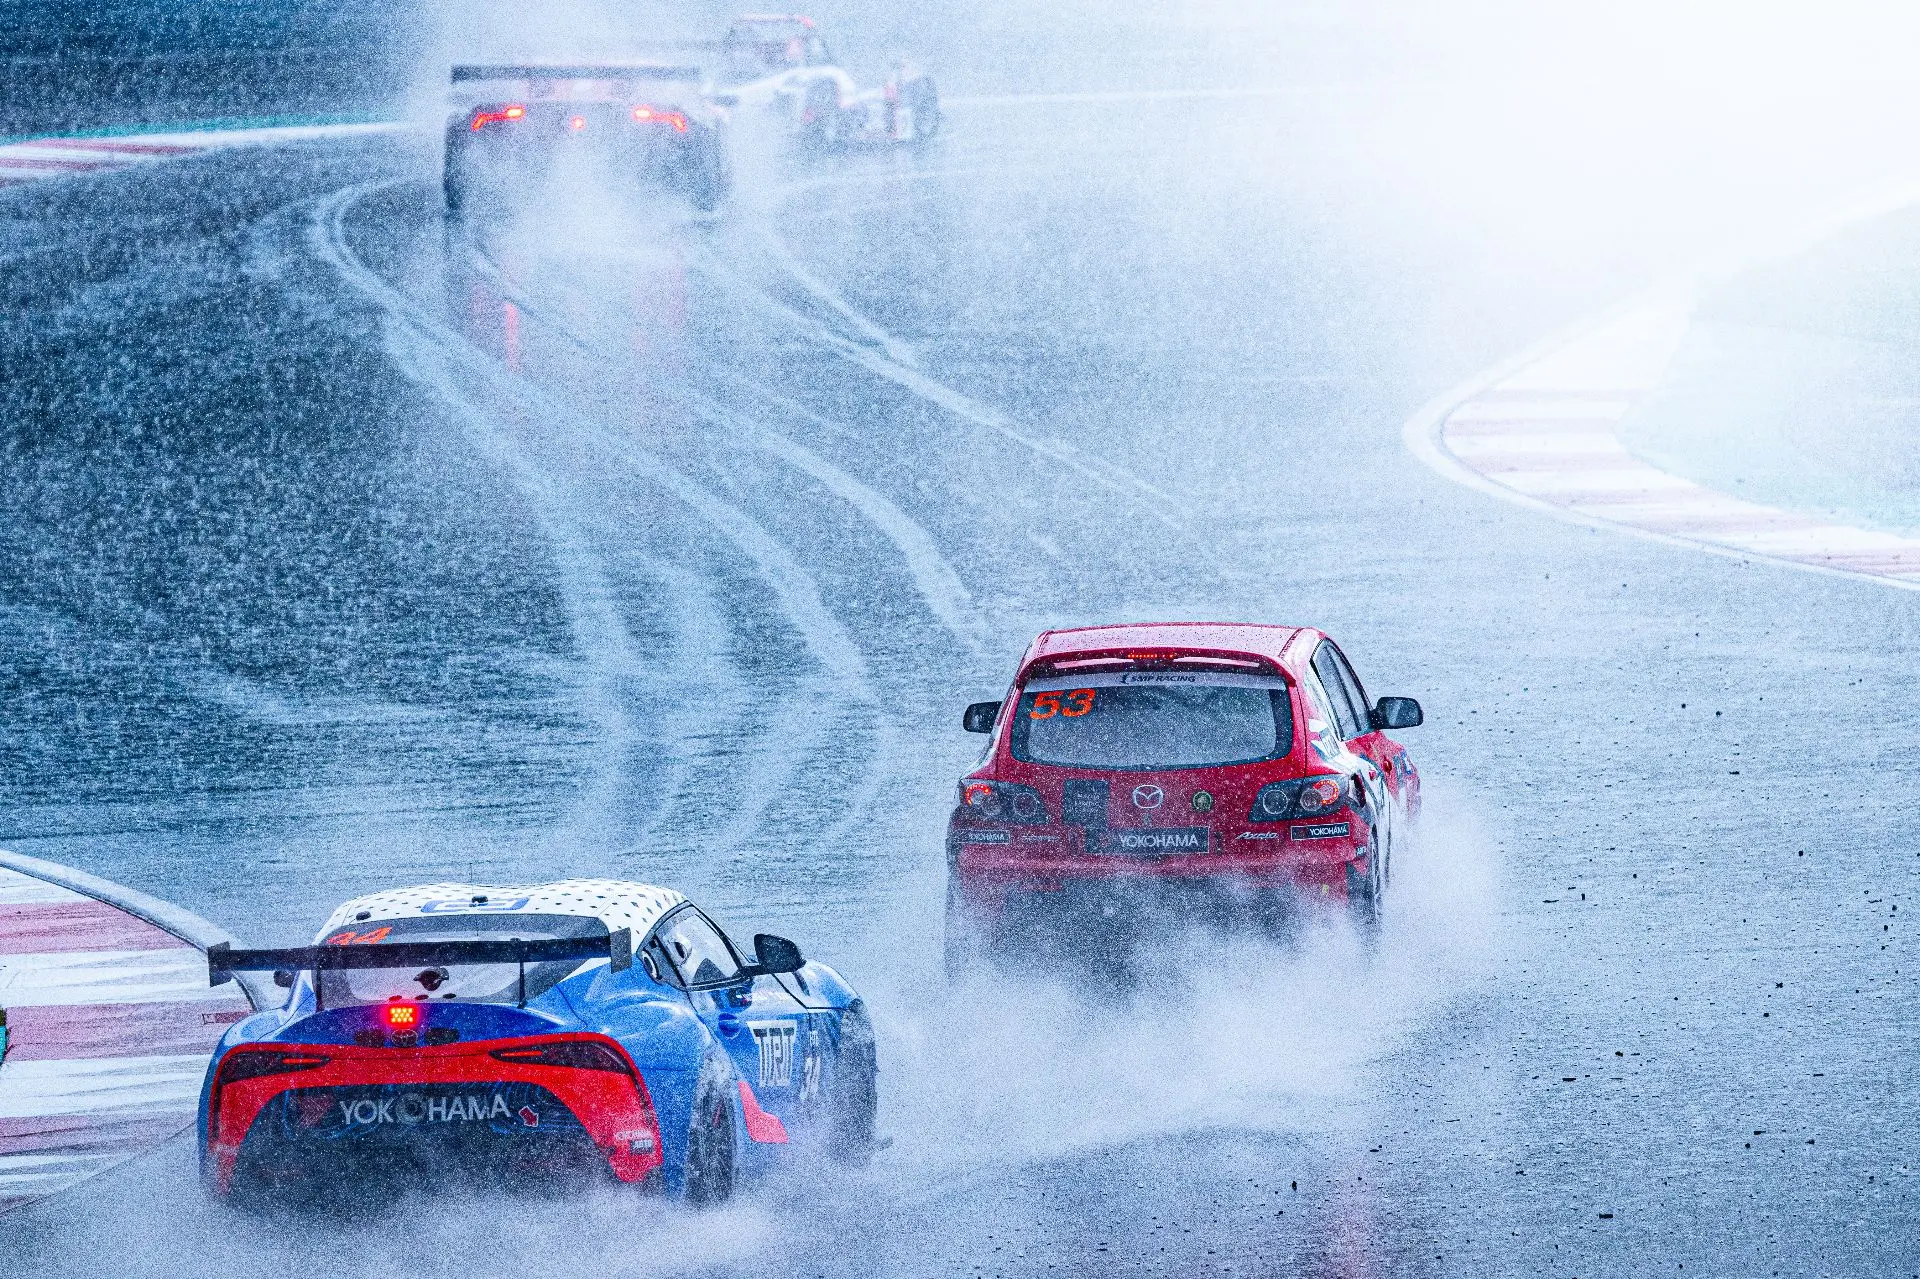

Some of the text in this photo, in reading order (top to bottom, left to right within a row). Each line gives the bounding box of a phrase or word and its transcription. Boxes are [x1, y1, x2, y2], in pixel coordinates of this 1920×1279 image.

[1131, 675, 1196, 683] SMP RACING
[1030, 688, 1095, 720] 53
[1309, 824, 1348, 836] YOKOHAMA
[1119, 833, 1199, 847] YOKOHAMA
[339, 1093, 511, 1125] YOKOHAMA
